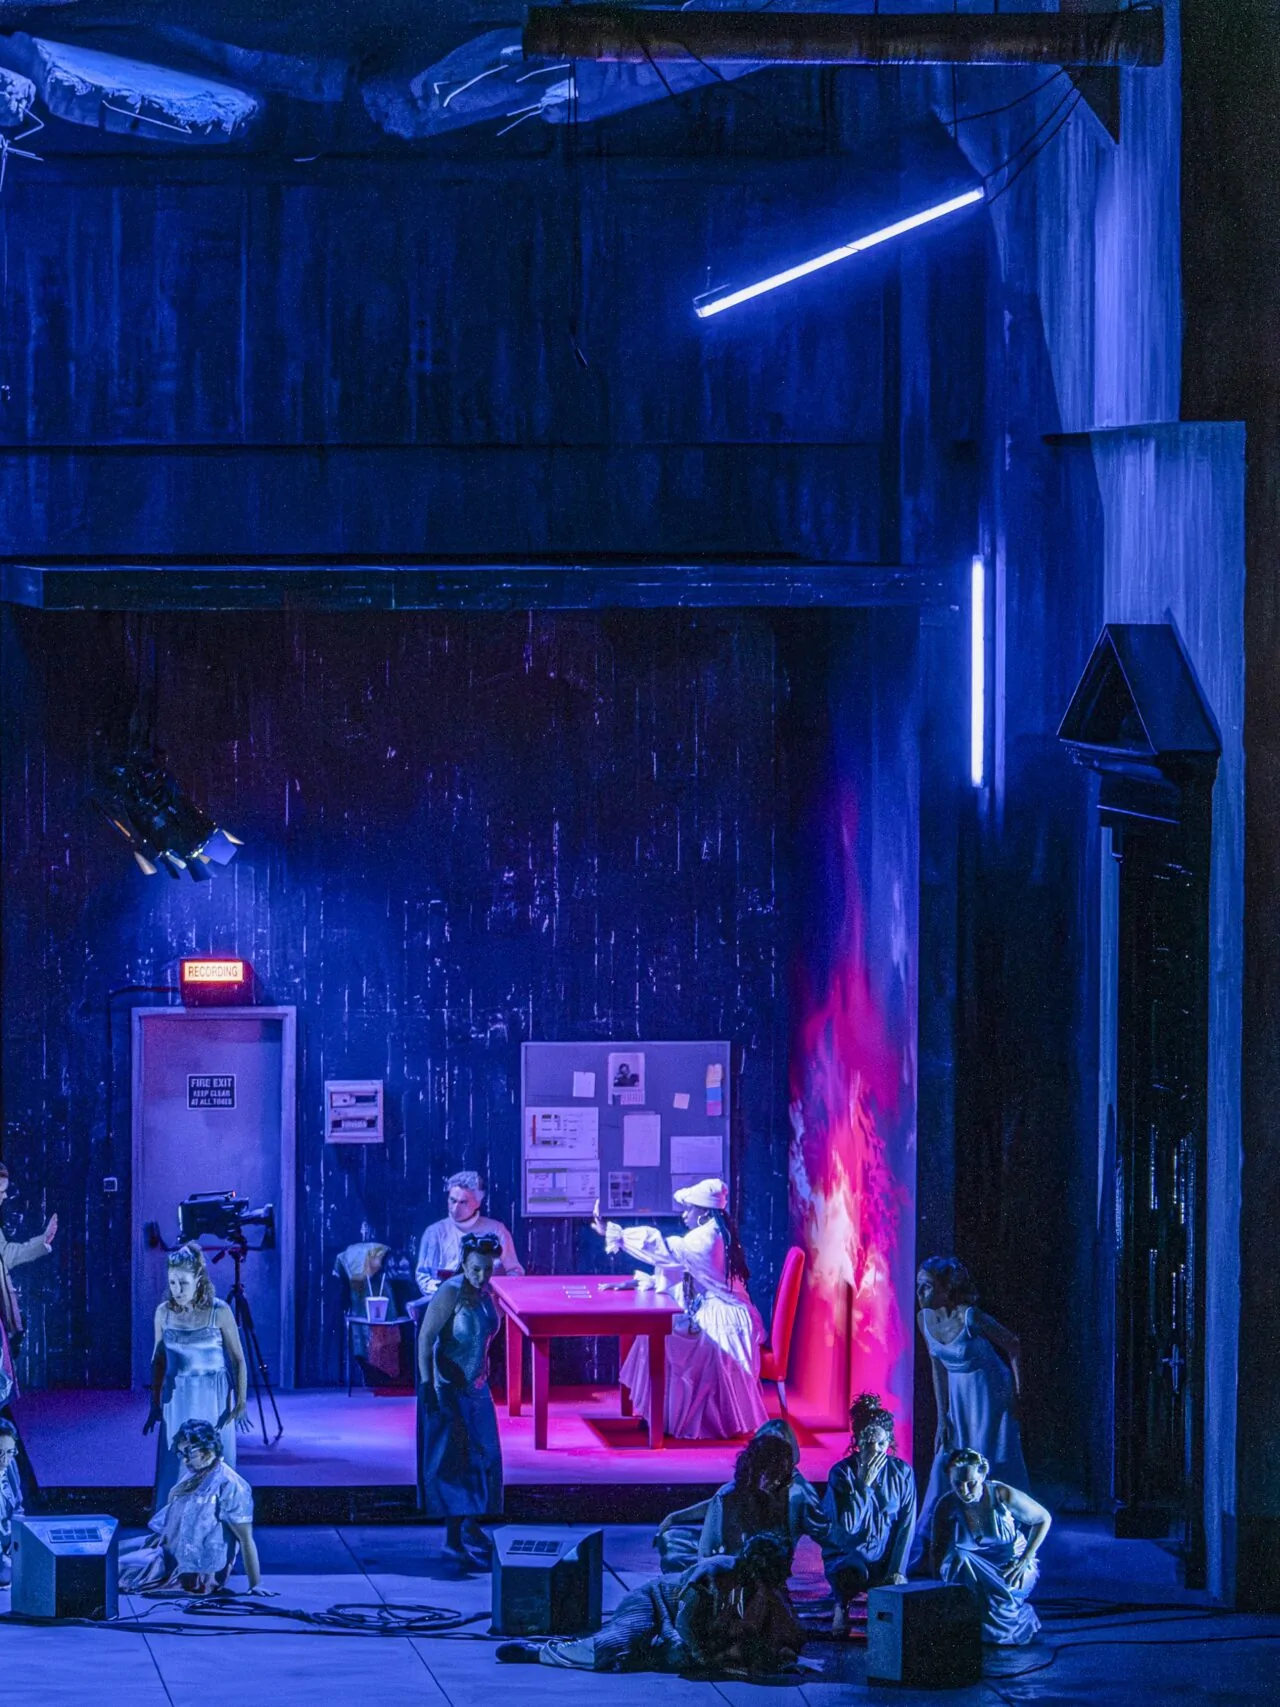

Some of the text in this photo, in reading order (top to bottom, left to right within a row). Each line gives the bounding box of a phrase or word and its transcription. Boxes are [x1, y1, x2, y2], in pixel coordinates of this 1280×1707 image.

[188, 966, 238, 977] RECORDING
[191, 1078, 232, 1088] FIRE EXIT
